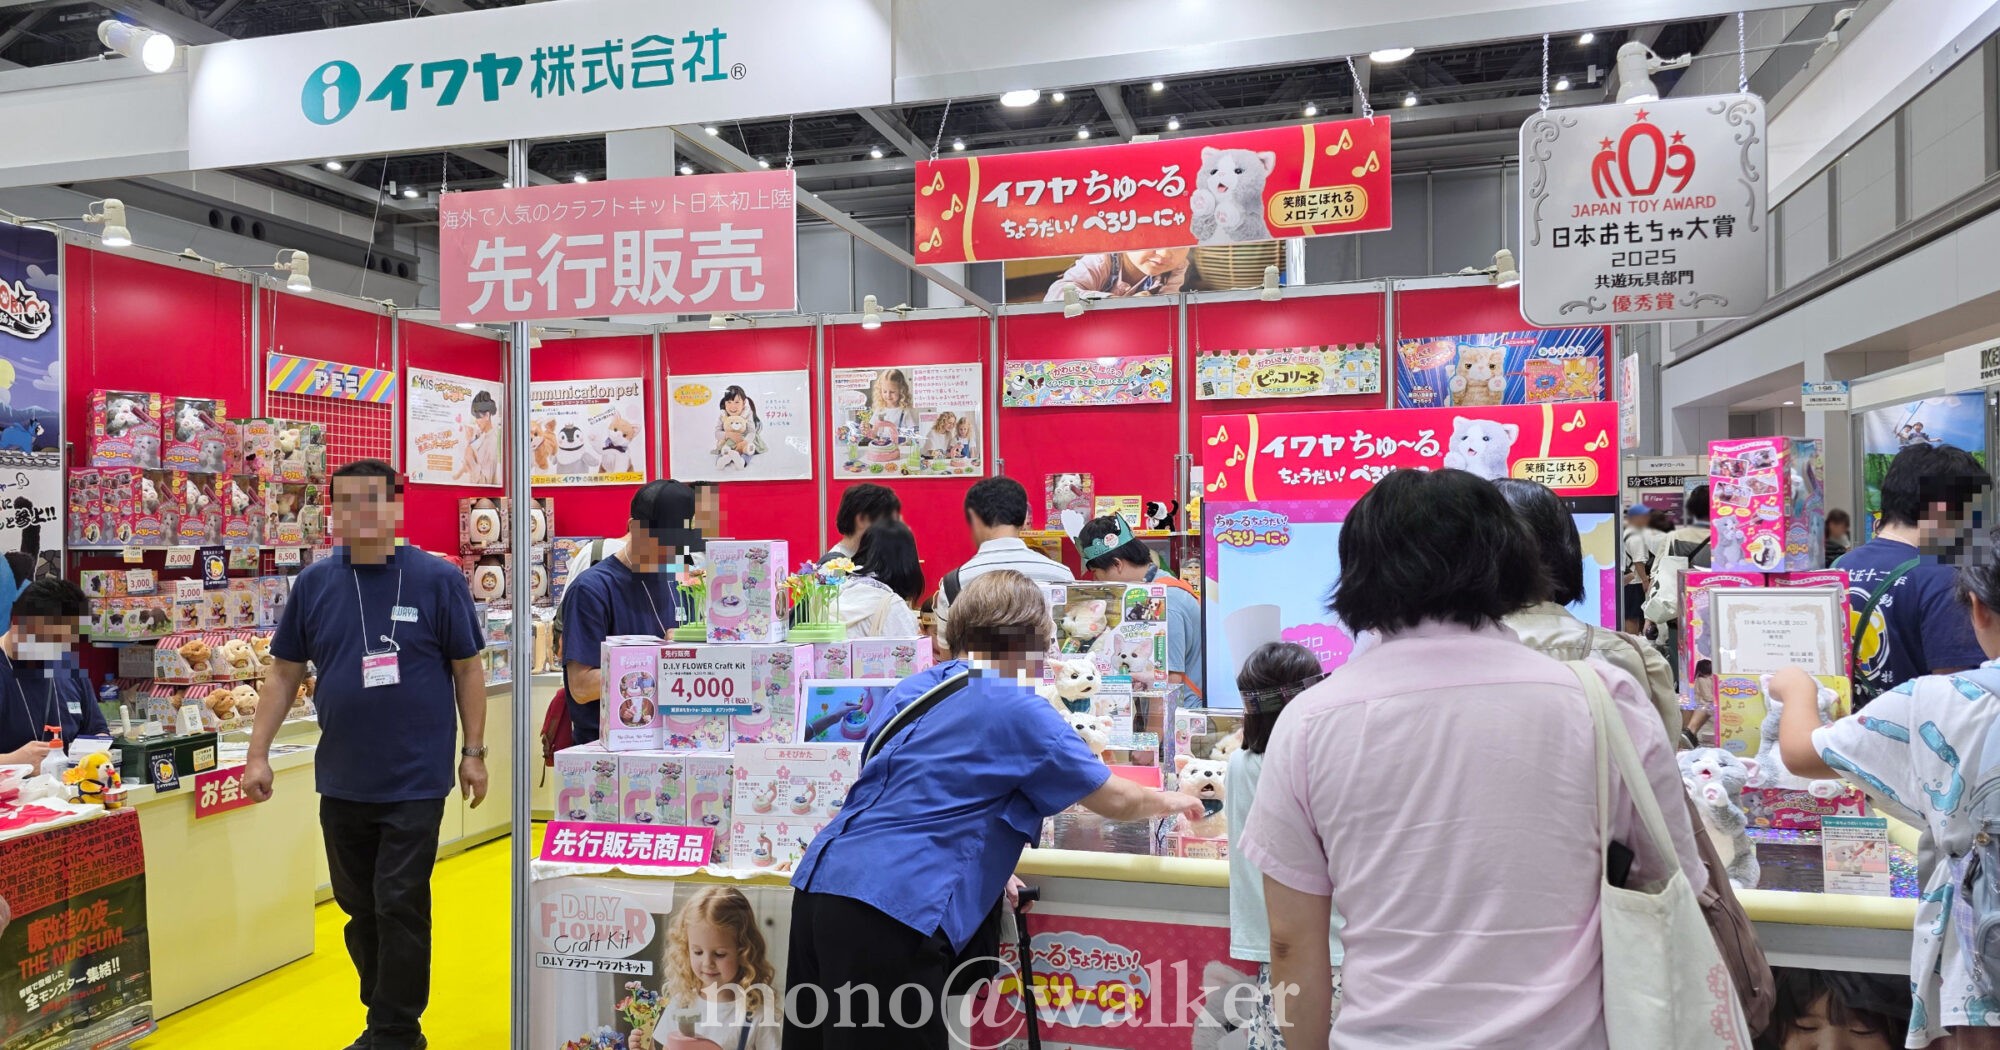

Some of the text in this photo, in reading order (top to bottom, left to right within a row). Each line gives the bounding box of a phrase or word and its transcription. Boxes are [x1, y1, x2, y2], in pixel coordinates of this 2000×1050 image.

[441, 187, 793, 230] 海外で人気のクラフトキット日本初上陸
[1282, 190, 1356, 209] 笑顔こぼれる
[1570, 195, 1717, 218] JAPAN TOY AWARD
[1082, 208, 1186, 232] ぺろりーにゃ
[1284, 203, 1355, 223] メロディ入り
[1552, 214, 1736, 248] 日本おもちゃ大賞
[466, 222, 766, 316] 先行販売
[1611, 249, 1677, 268] 2025
[1594, 269, 1695, 290] 共遊玩具部門
[1611, 292, 1676, 313] 優秀賞
[313, 368, 360, 394] PEZ
[1256, 369, 1320, 388] ピッコリーネ
[616, 382, 639, 401] pet
[1260, 434, 1345, 458] イワヤ
[1524, 462, 1586, 474] 笑顔こぼれる
[1215, 528, 1290, 547] ぺろりーにゃ
[169, 552, 191, 564] 8,000
[277, 552, 297, 562] 8,500
[130, 578, 150, 590] 3,000
[180, 588, 200, 598] 3,000
[663, 662, 746, 670] D.I.Y FLOWER Craft Kit
[671, 677, 734, 703] 4,000
[778, 750, 814, 759] あそびかた
[201, 774, 247, 809] お会
[550, 828, 706, 863] 先行販売商品
[92, 847, 138, 868] MUSEUM
[560, 894, 622, 921] D.I.Y
[540, 902, 648, 945] FLOWER
[553, 929, 632, 954] Craft Kit
[18, 953, 49, 980] THE
[542, 957, 647, 973] D.I.Y フラワークラフトキット
